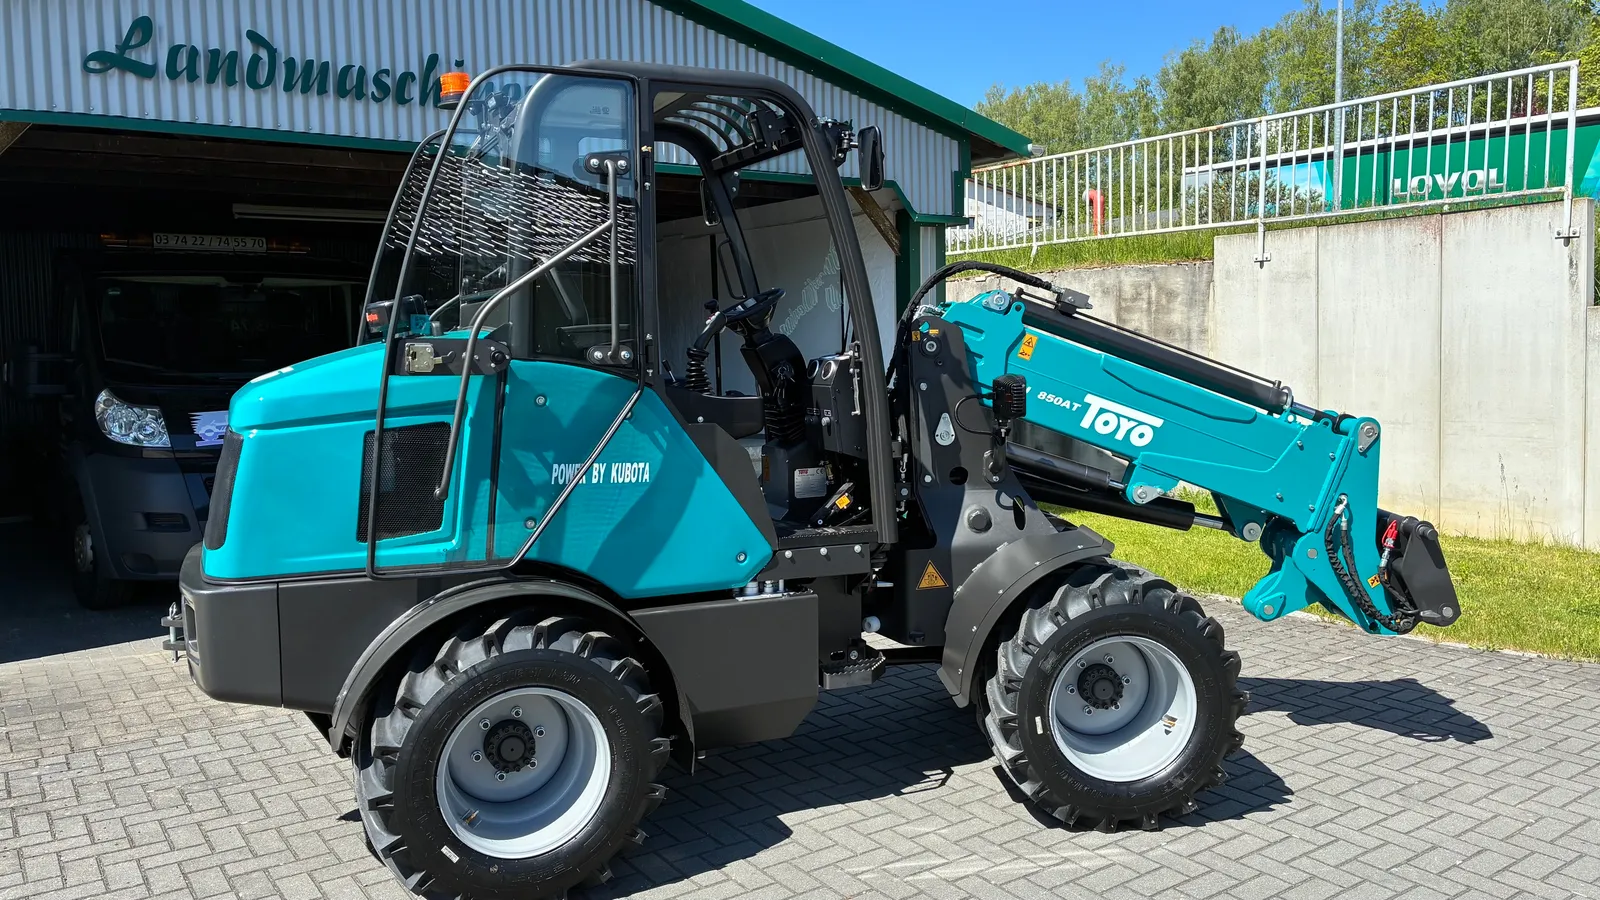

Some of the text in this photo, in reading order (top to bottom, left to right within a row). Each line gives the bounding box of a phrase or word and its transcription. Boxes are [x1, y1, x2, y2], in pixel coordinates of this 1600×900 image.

[1393, 168, 1504, 196] LOVOL
[155, 234, 169, 245] 03
[173, 235, 188, 246] 74
[191, 236, 205, 246] 22
[216, 237, 230, 247] 74
[233, 237, 247, 248] 55
[251, 238, 264, 248] 70
[1037, 391, 1165, 447] 850AT TOYO
[591, 463, 607, 484] BY
[610, 462, 650, 484] KUBOTA
